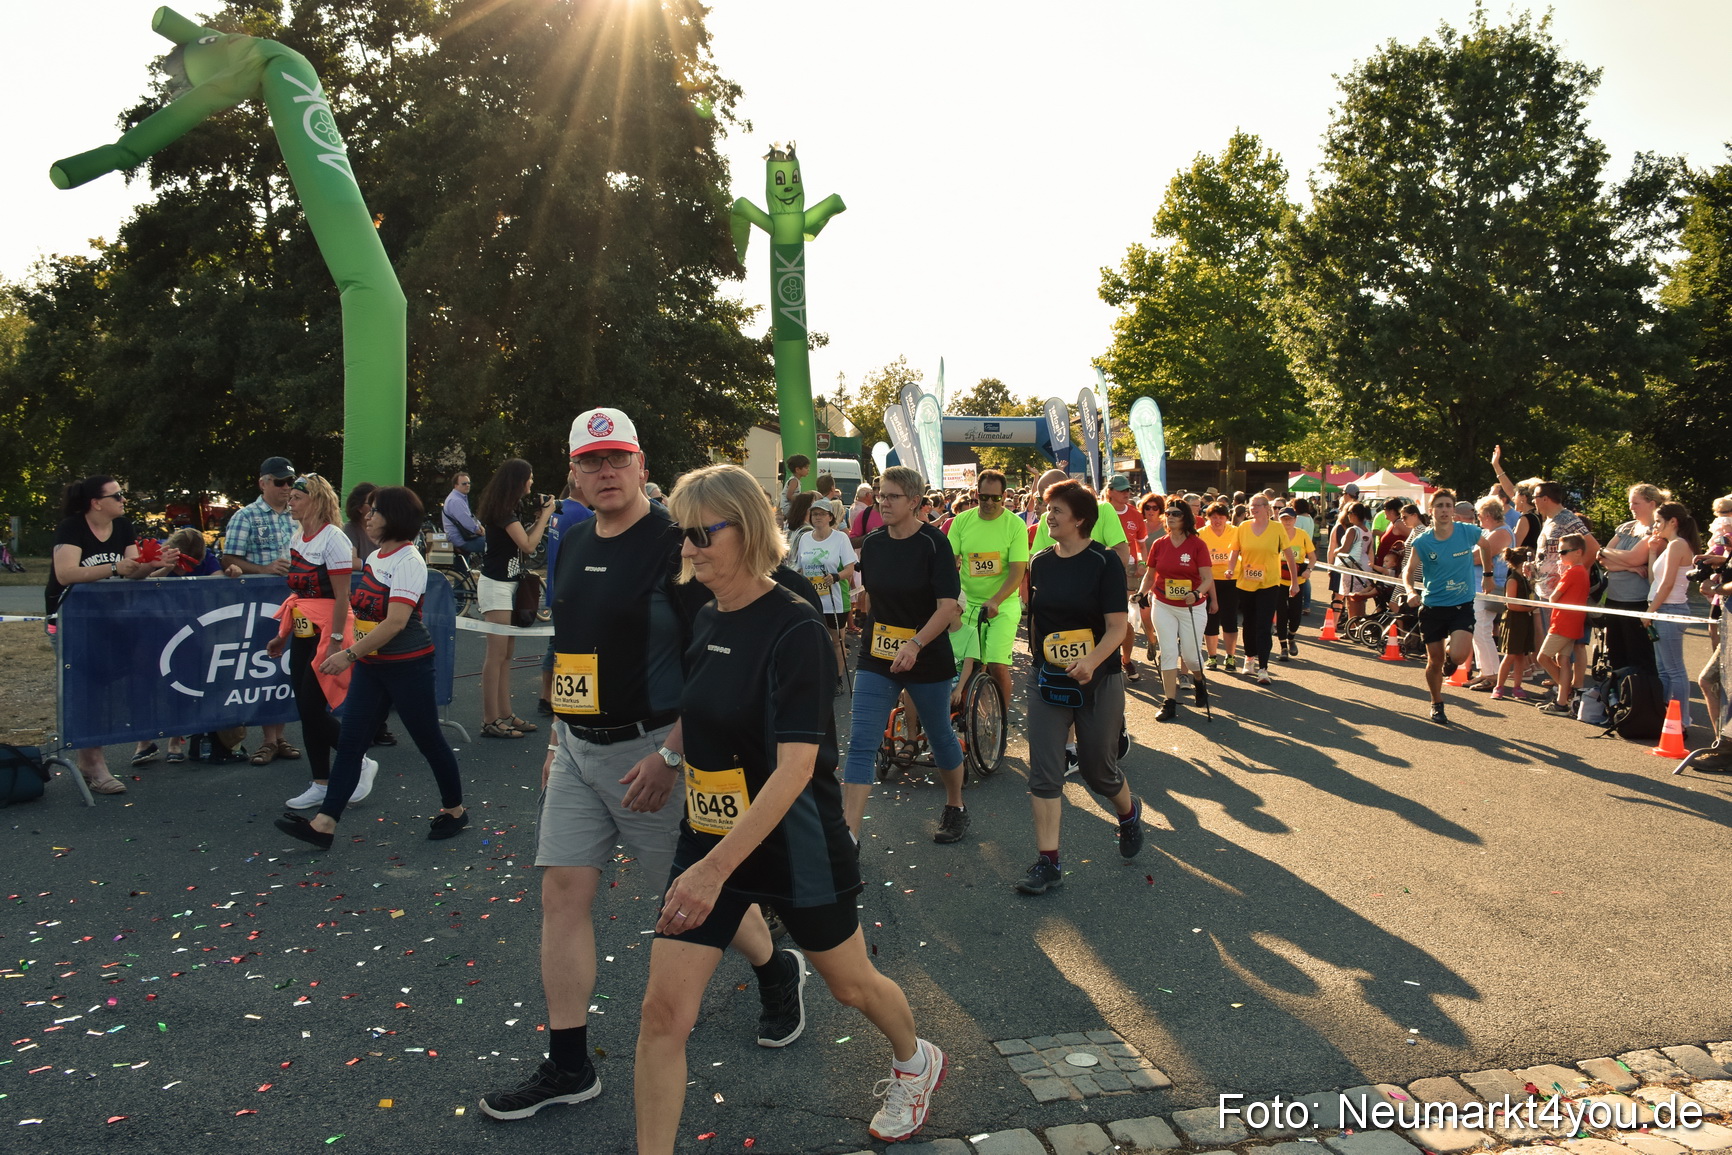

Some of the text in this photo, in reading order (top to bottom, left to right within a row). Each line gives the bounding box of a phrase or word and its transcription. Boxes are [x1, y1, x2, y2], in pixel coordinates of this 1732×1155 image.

[281, 71, 358, 187] AOK
[776, 249, 807, 330] AOK
[977, 432, 1014, 440] firmenlauf
[975, 560, 994, 571] 349
[1245, 569, 1263, 578] 1666
[1169, 586, 1186, 595] 366
[877, 636, 908, 652] 164
[1050, 642, 1087, 659] 1651
[224, 684, 295, 706] AUTO
[690, 788, 738, 818] 1648
